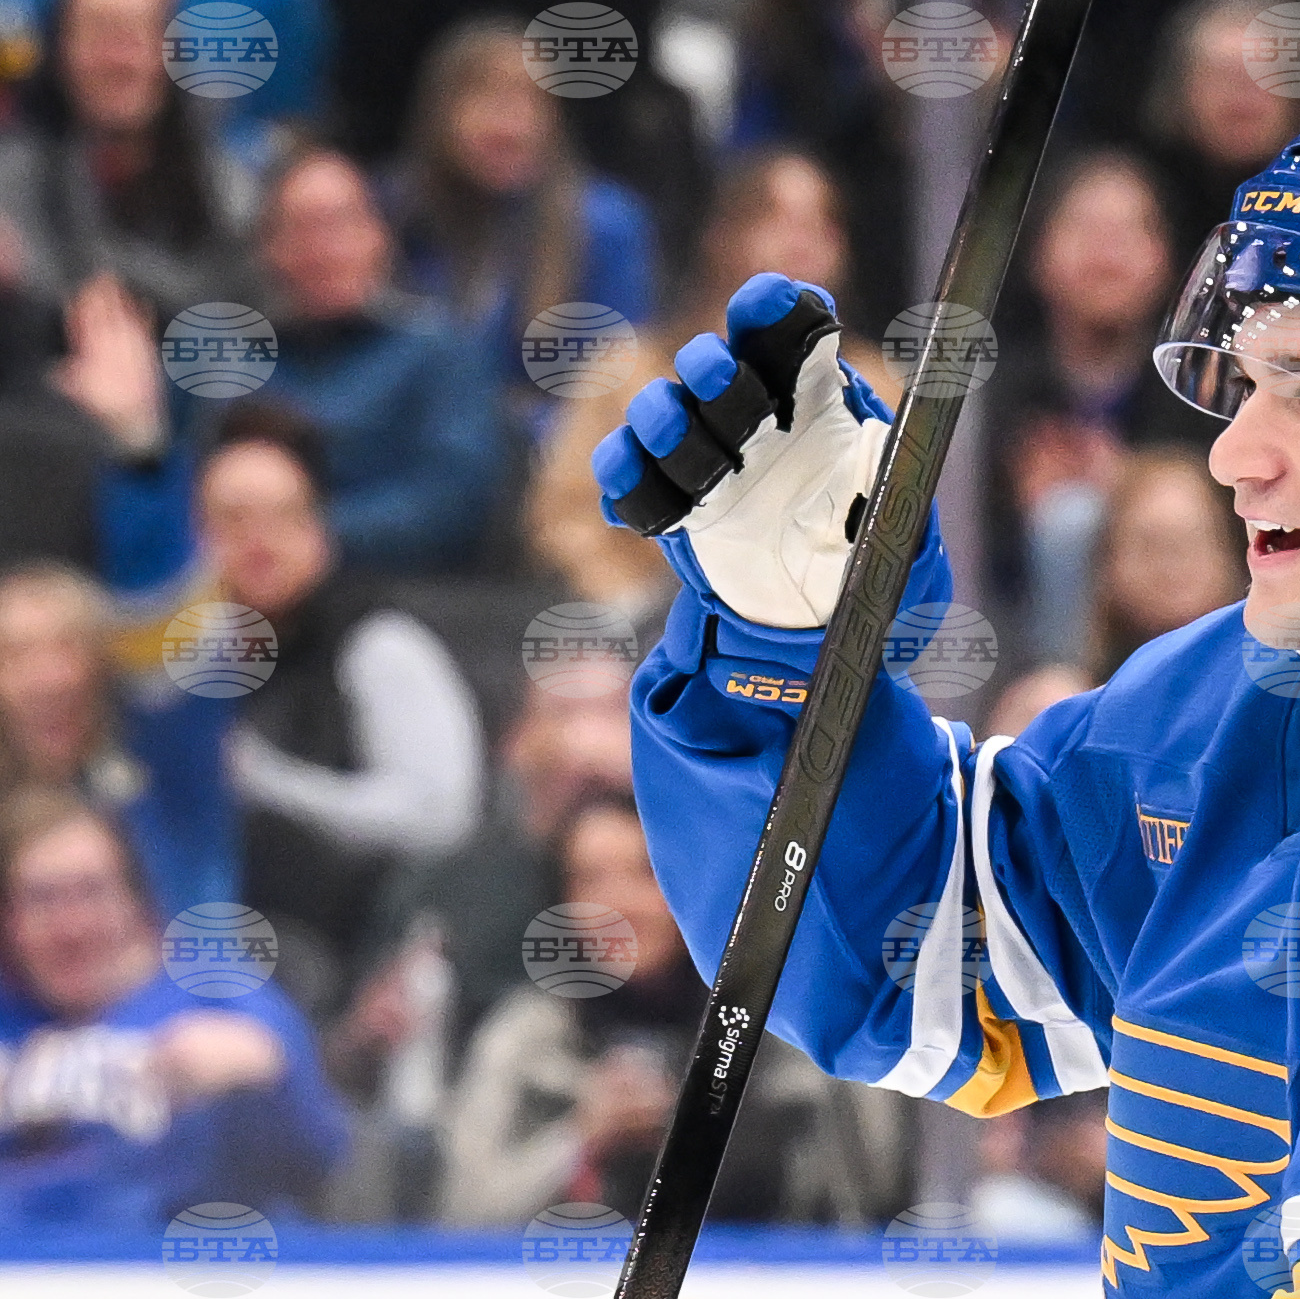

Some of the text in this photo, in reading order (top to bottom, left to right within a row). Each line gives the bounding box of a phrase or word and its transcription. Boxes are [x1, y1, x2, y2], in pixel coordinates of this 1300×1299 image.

[727, 680, 808, 703] CCM
[784, 841, 807, 871] 8
[774, 869, 796, 912] PRO
